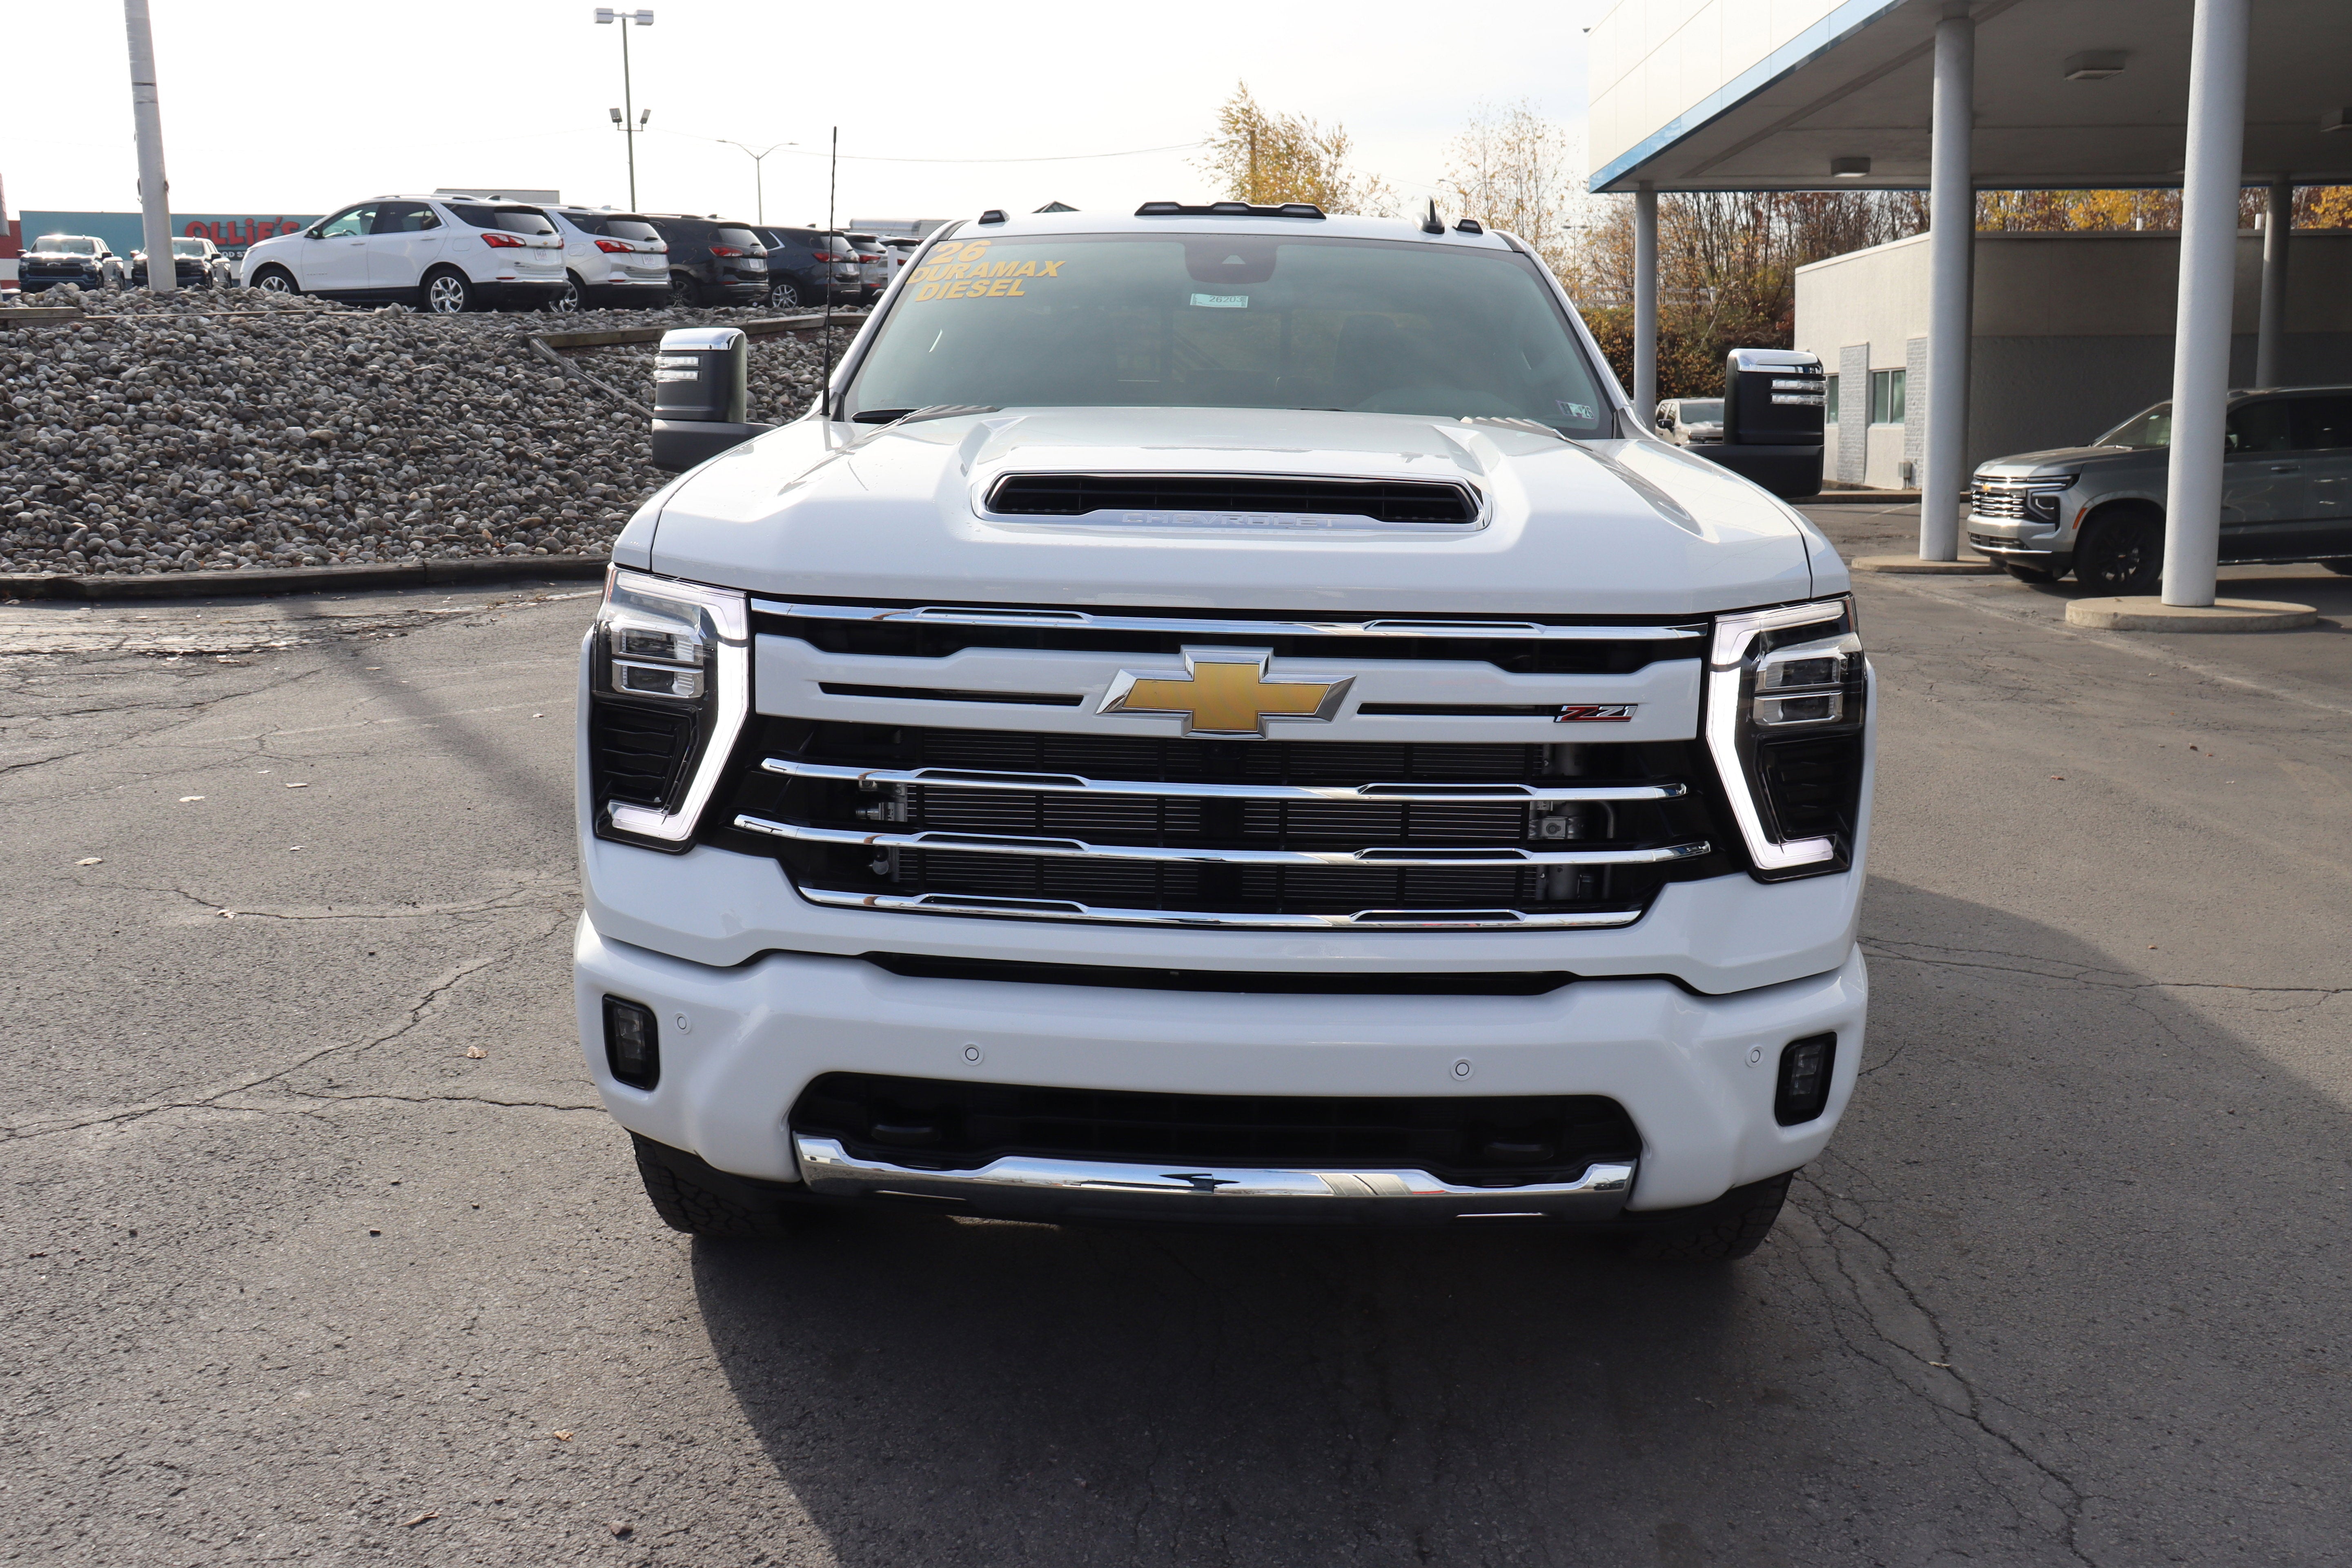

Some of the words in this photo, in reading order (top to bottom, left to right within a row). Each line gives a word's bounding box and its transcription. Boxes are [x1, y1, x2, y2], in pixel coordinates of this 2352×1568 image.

[905, 260, 1067, 284] DURAMAX
[915, 279, 1026, 302] DIESEL
[1582, 406, 1594, 418] 26
[1121, 512, 1341, 527] CHEVROLET
[1555, 705, 1638, 722] Z71
